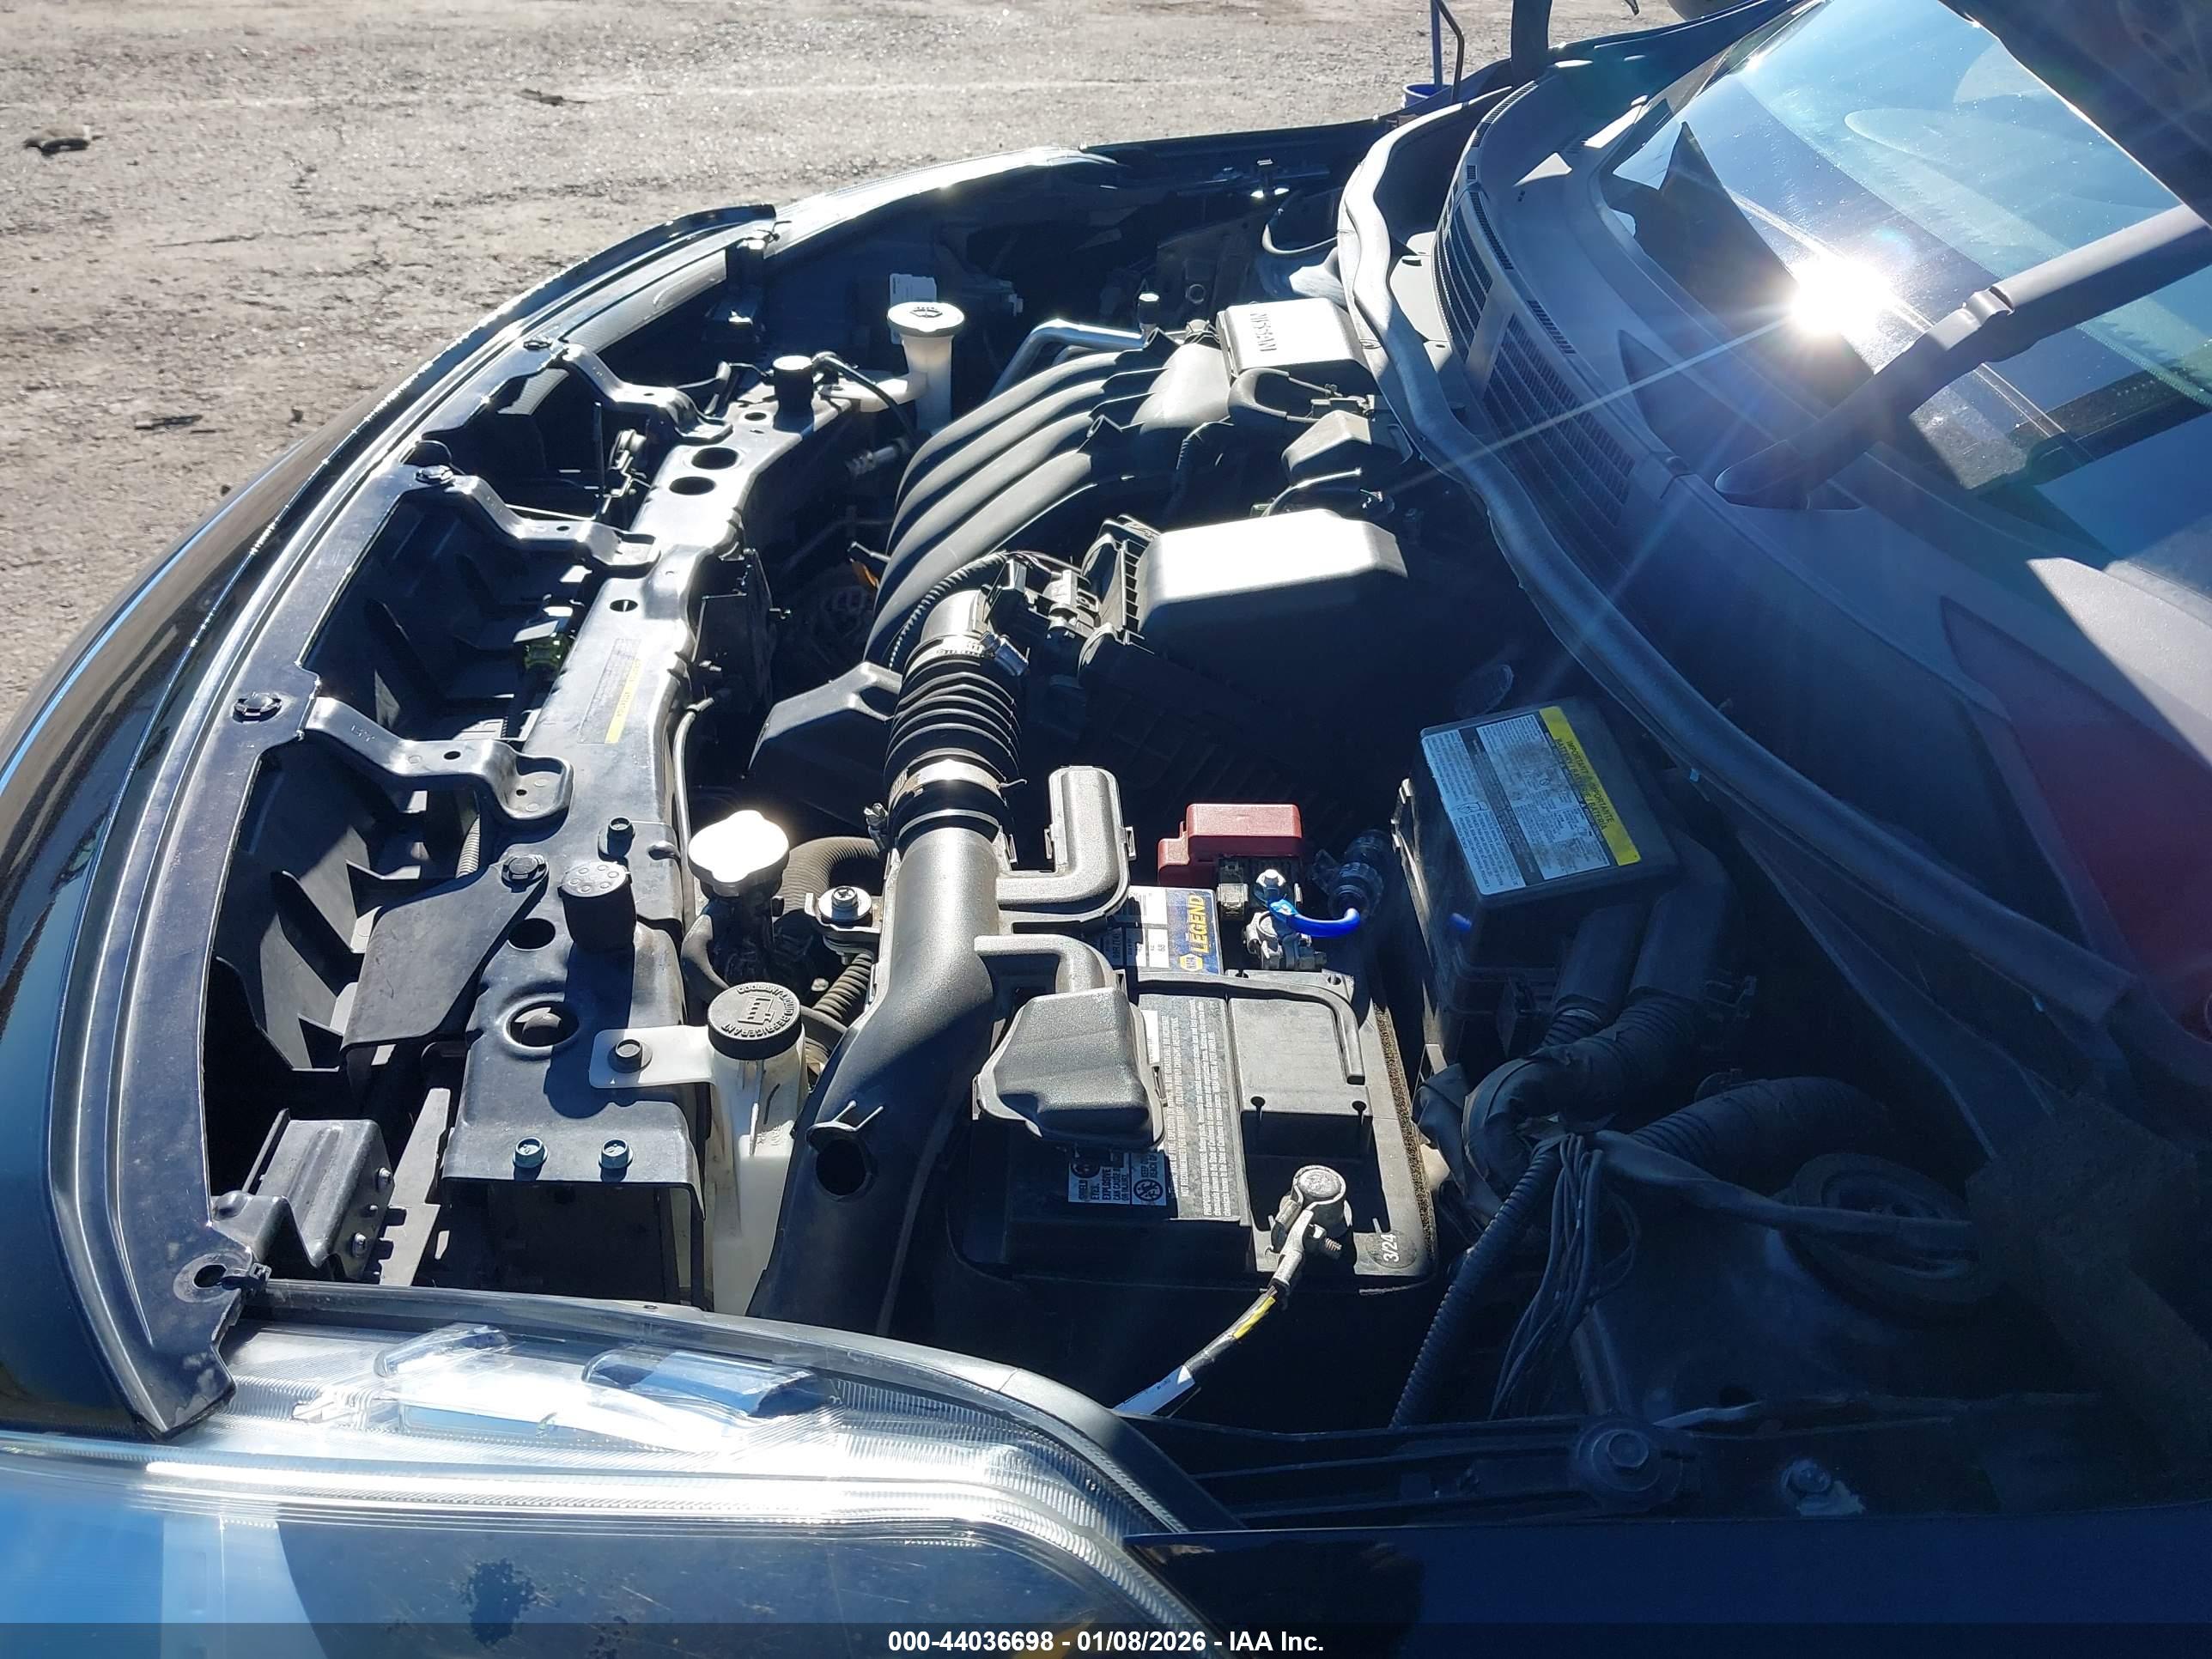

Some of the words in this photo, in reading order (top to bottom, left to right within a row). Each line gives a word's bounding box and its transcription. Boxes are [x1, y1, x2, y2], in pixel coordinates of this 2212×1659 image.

[1250, 313, 1277, 352] NISSAN
[1556, 738, 1571, 764] BATTERY
[1566, 740, 1589, 774] IMPORTANT
[1187, 895, 1209, 953] LEGEND
[1178, 1149, 1188, 1186] RECOMMENDED
[1102, 1169, 1111, 1200] EXPLOSIVE
[1181, 1187, 1189, 1196] NOT
[1201, 1182, 1212, 1215] PROPOSITION
[1212, 1193, 1221, 1216] chemicals
[1221, 1193, 1231, 1216] chemicals
[1381, 1234, 1400, 1262] 3/24
